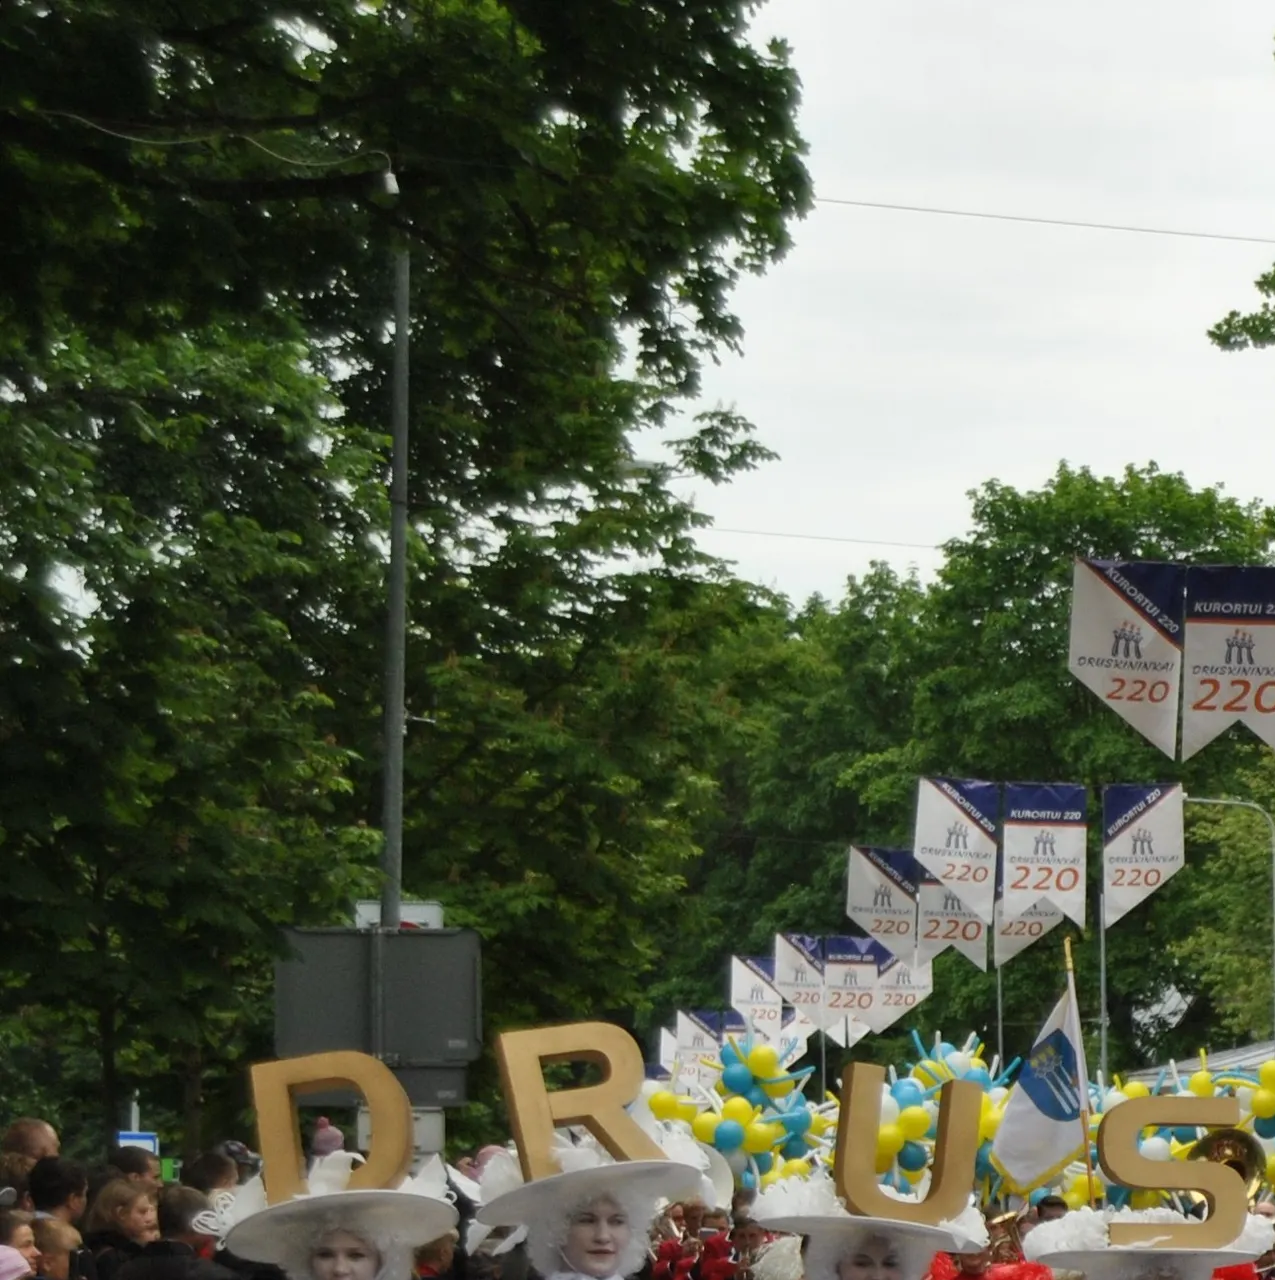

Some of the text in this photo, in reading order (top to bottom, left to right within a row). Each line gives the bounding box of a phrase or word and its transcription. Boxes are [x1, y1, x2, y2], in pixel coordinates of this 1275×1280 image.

[1103, 566, 1180, 635] KURORTUI 220
[1193, 601, 1263, 615] KURORTUI
[1076, 654, 1175, 673] DRUSKININKAI
[1105, 676, 1171, 704] 220
[1010, 808, 1082, 821] KURORTUI 220
[941, 862, 989, 884] 220
[1010, 866, 1081, 892] 220
[1110, 868, 1162, 888] 220
[870, 918, 911, 936] 220
[923, 918, 982, 942] 220
[792, 991, 821, 1005] 220
[828, 991, 874, 1010] 220
[882, 992, 917, 1007] 220
